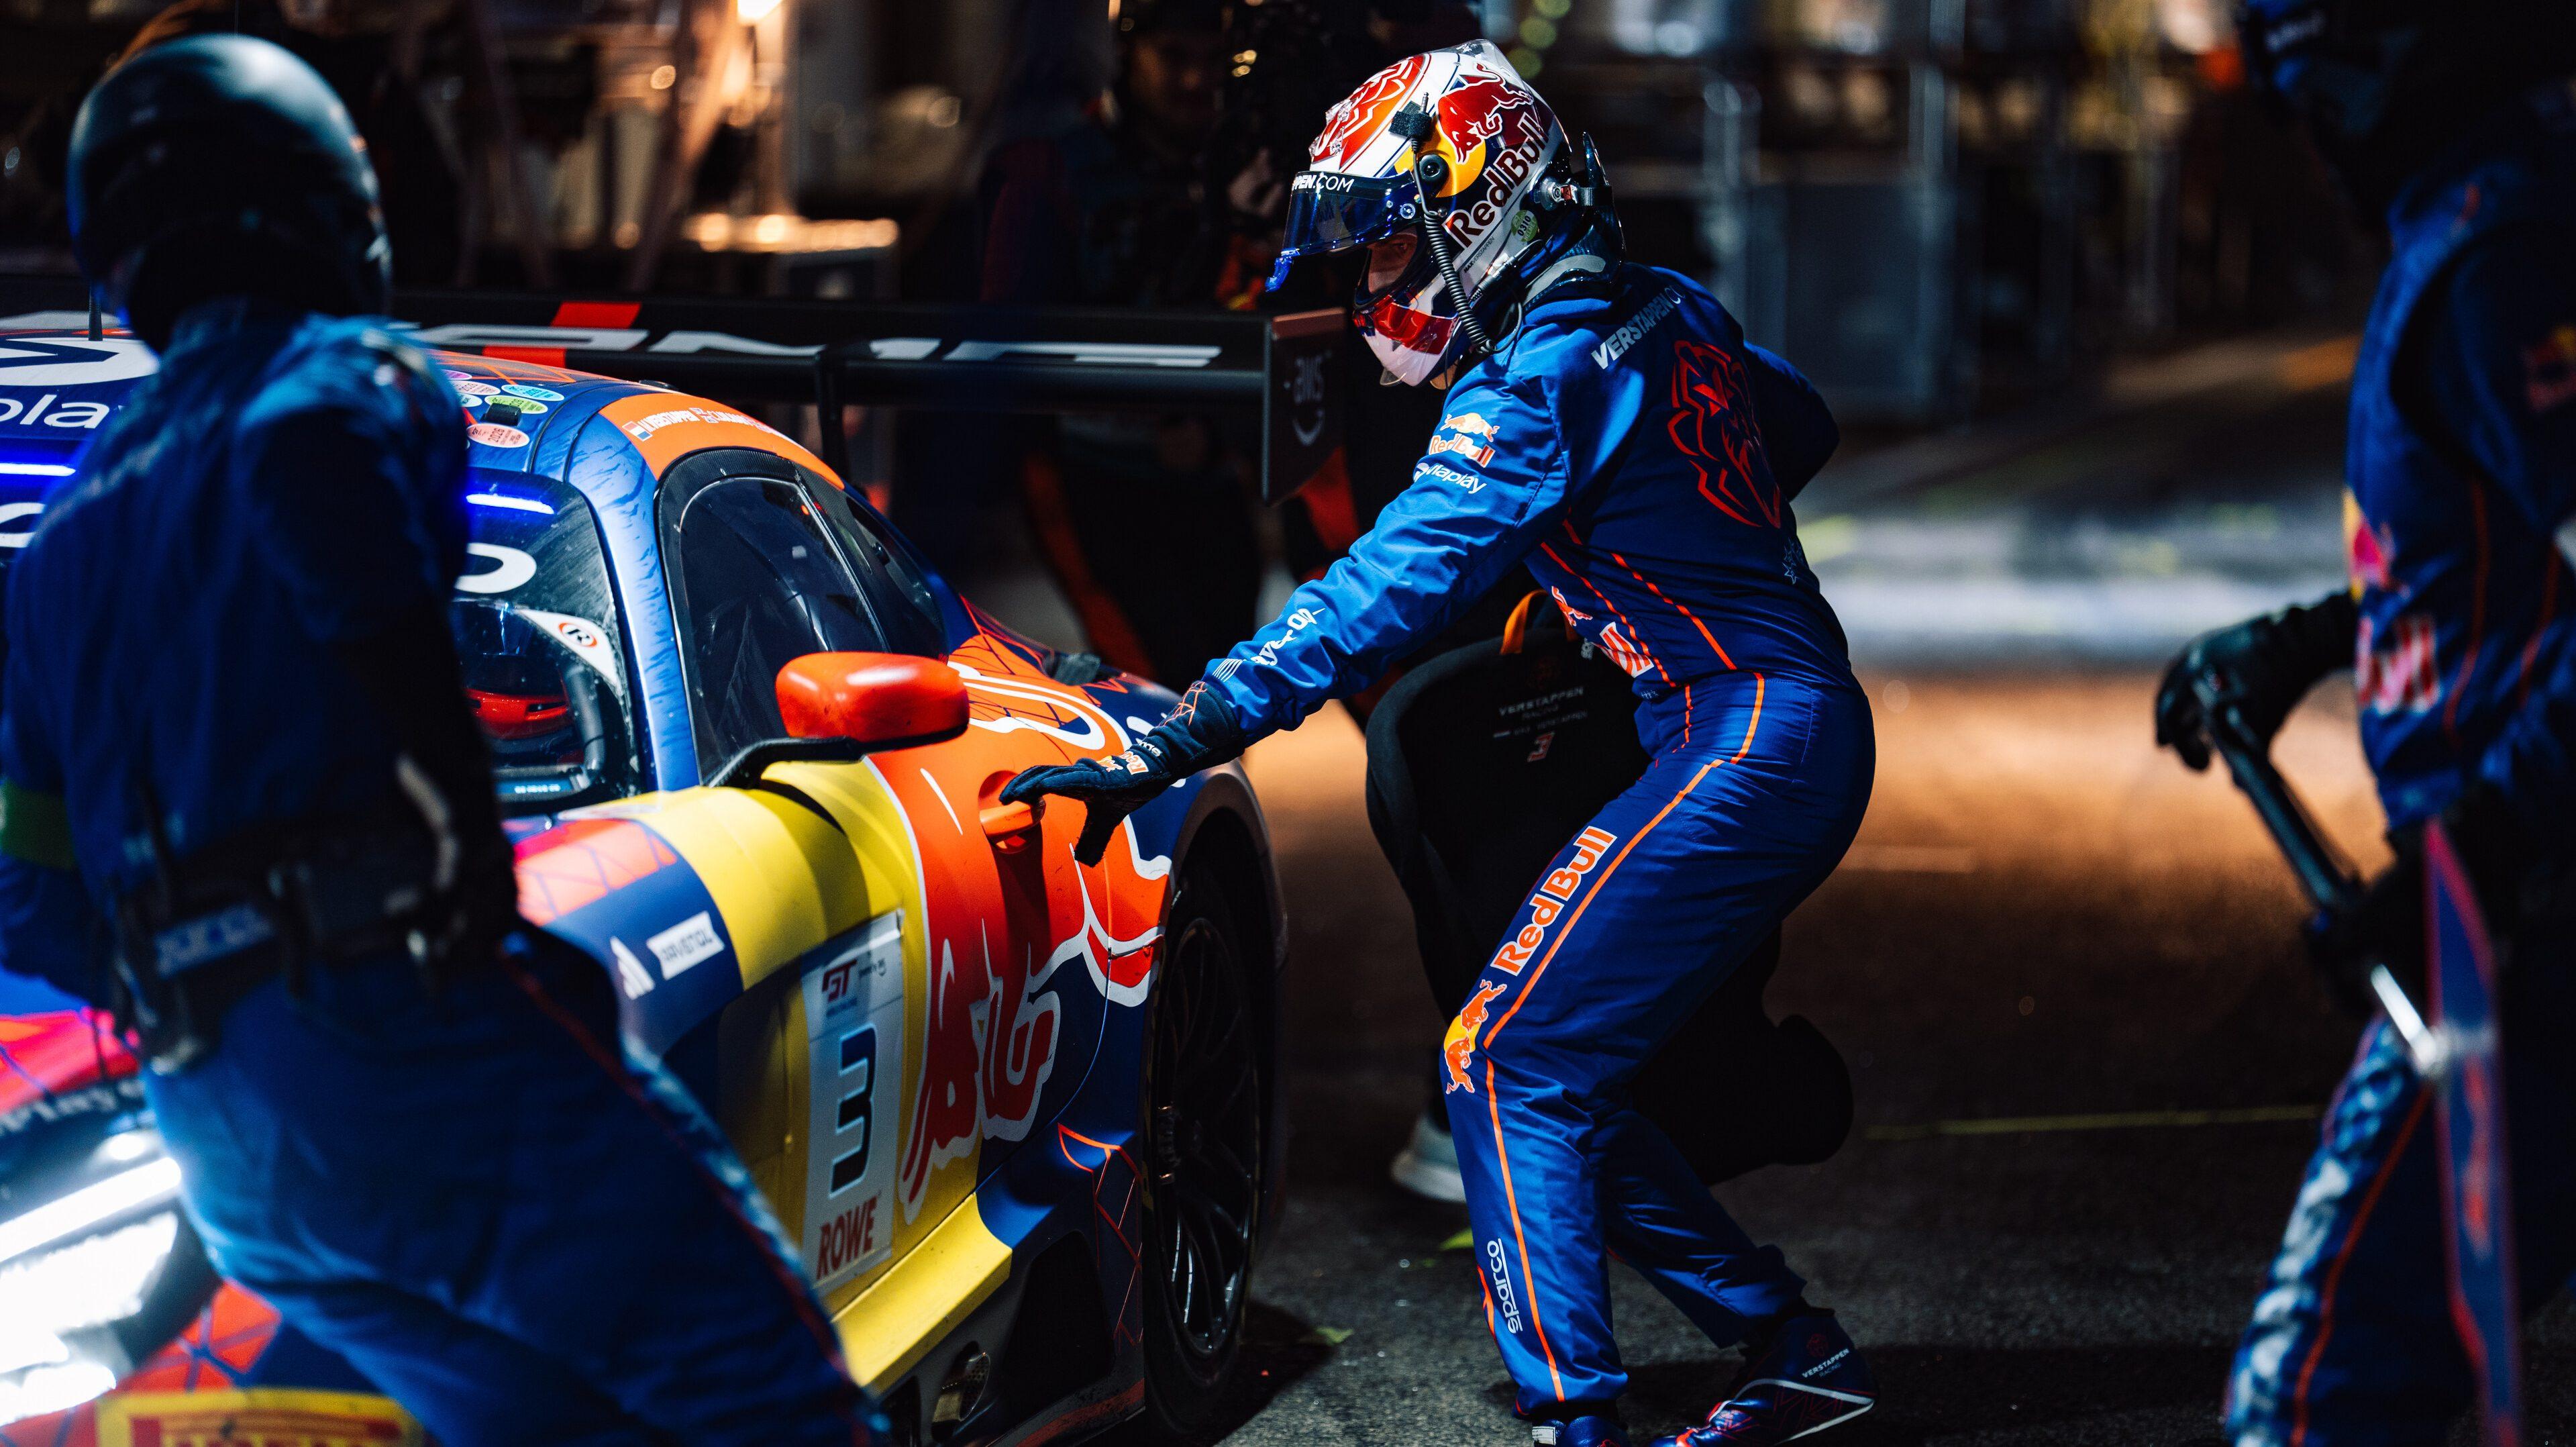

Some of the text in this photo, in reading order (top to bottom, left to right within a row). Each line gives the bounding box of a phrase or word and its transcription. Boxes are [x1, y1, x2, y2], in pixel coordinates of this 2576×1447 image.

[1517, 215, 1531, 236] 0310
[1490, 826, 1618, 977] Red Bull
[815, 1024, 876, 1199] 3
[816, 1197, 878, 1280] ROWE
[1487, 1238, 1523, 1334] sparco
